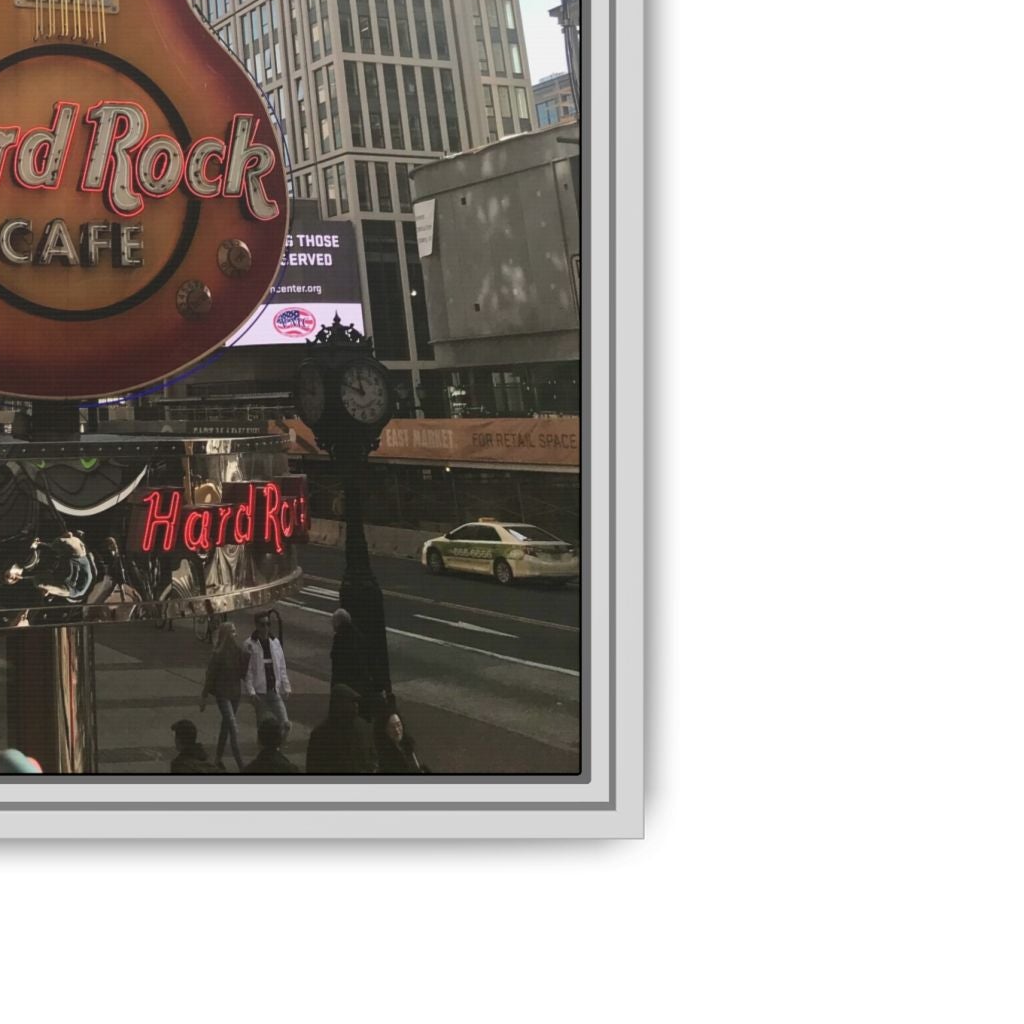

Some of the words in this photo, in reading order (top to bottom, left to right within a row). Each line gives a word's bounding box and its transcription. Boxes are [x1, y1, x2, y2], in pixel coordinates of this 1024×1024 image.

[81, 100, 279, 220] Rock
[296, 234, 340, 248] THOSE
[385, 429, 409, 448] EAST
[472, 432, 494, 448] FOR
[495, 432, 535, 449] RETAIL
[538, 433, 576, 449] SPACE
[142, 483, 257, 552] Hard
